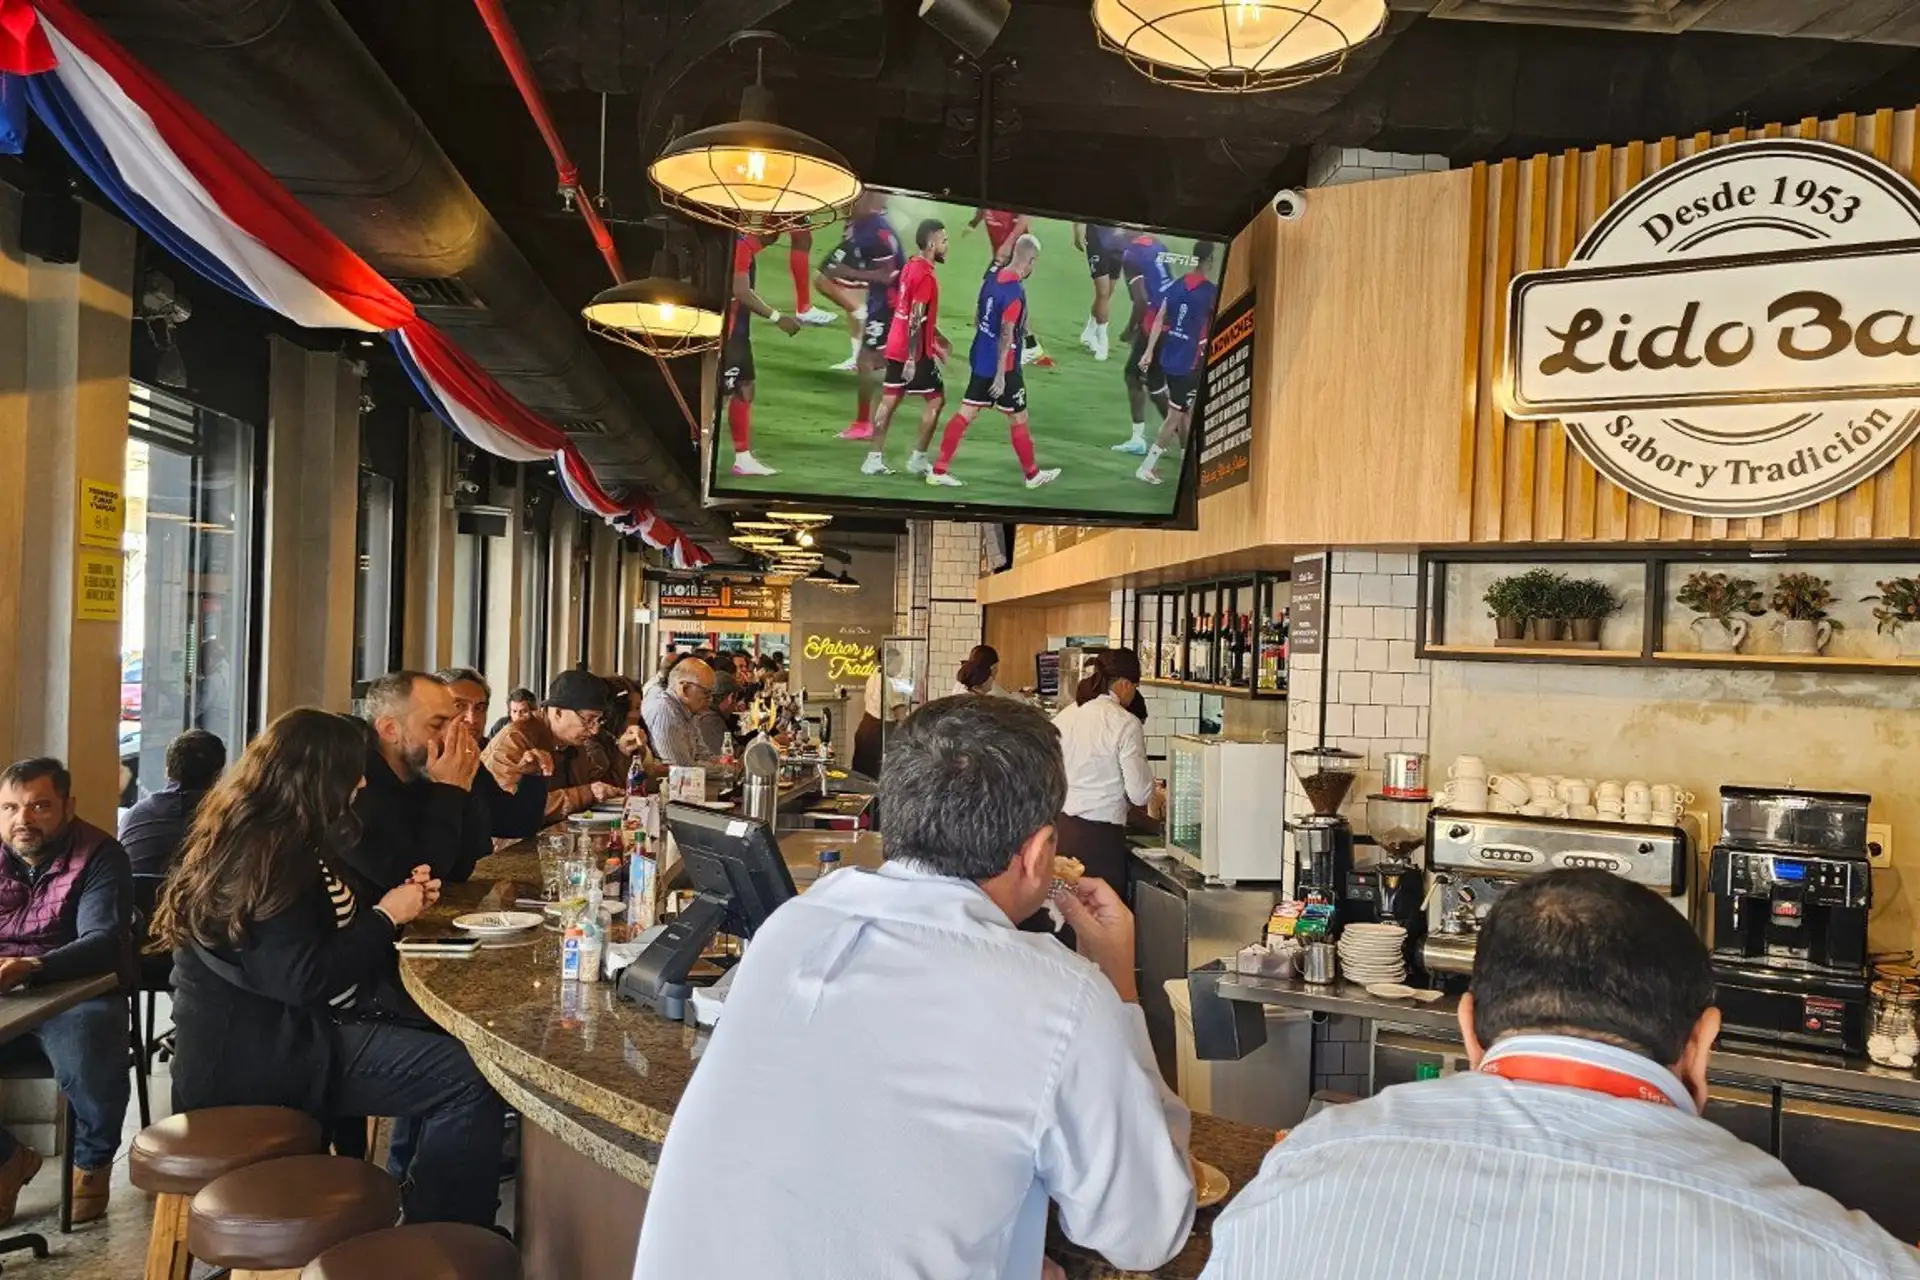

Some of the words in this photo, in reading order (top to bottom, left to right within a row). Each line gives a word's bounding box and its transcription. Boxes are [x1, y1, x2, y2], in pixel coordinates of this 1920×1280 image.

[1638, 181, 1757, 246] Desde
[1768, 175, 1862, 224] 1953
[1538, 301, 1756, 377] Lido
[1767, 290, 1920, 361] Ba
[1605, 414, 1694, 485] Sabor
[1695, 463, 1719, 488] y
[1724, 407, 1894, 486] Tradición
[804, 634, 861, 660] Sabor
